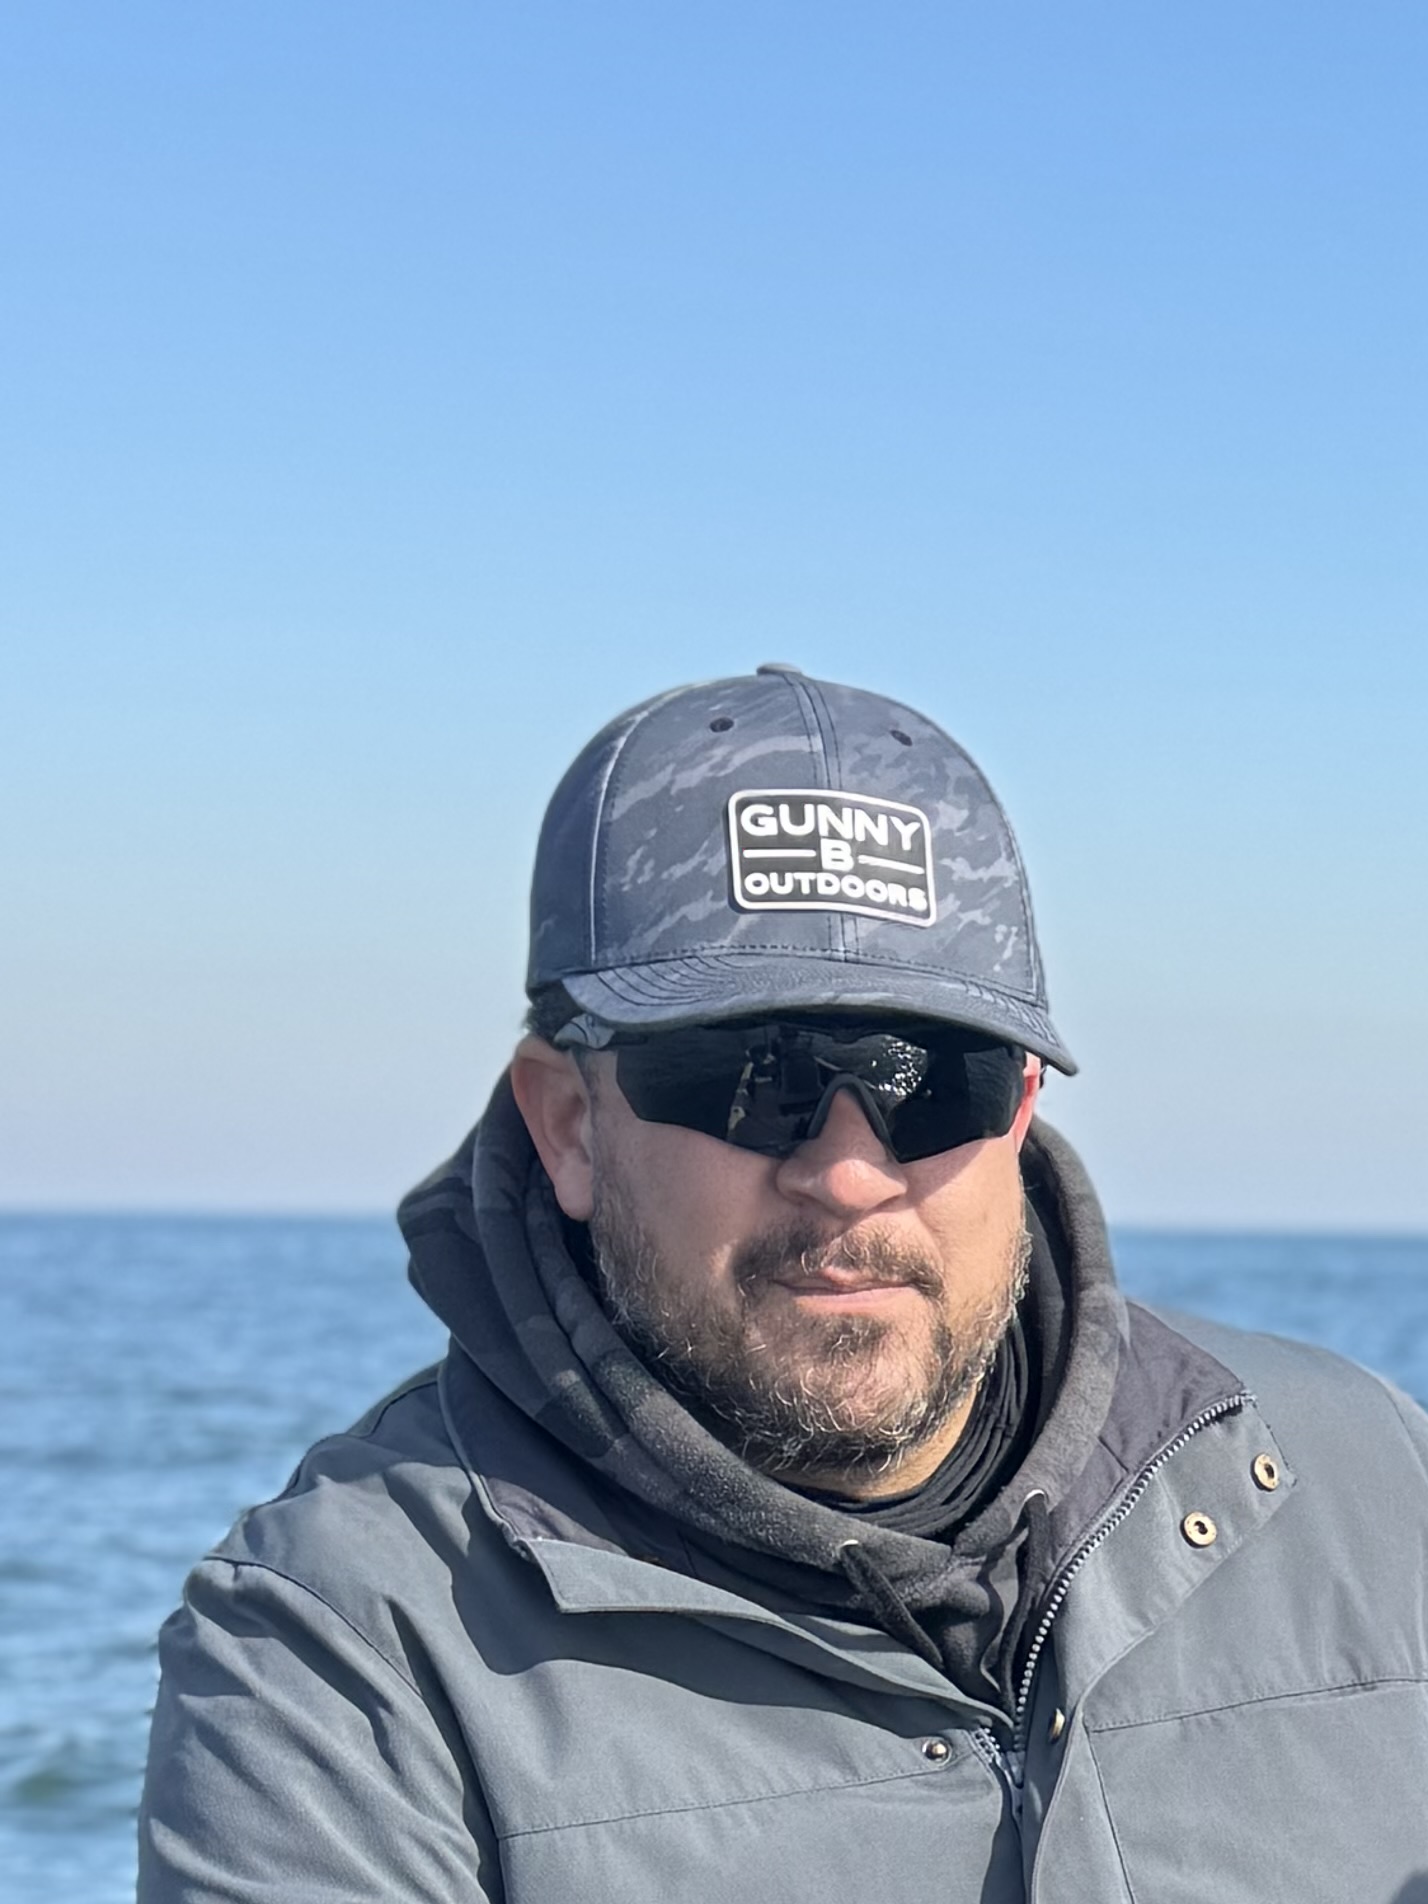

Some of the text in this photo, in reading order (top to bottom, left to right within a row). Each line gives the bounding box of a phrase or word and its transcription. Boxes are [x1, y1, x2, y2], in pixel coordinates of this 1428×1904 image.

[740, 803, 921, 851] GUNNY
[820, 837, 855, 872] B
[744, 871, 928, 912] OUTDOORS
